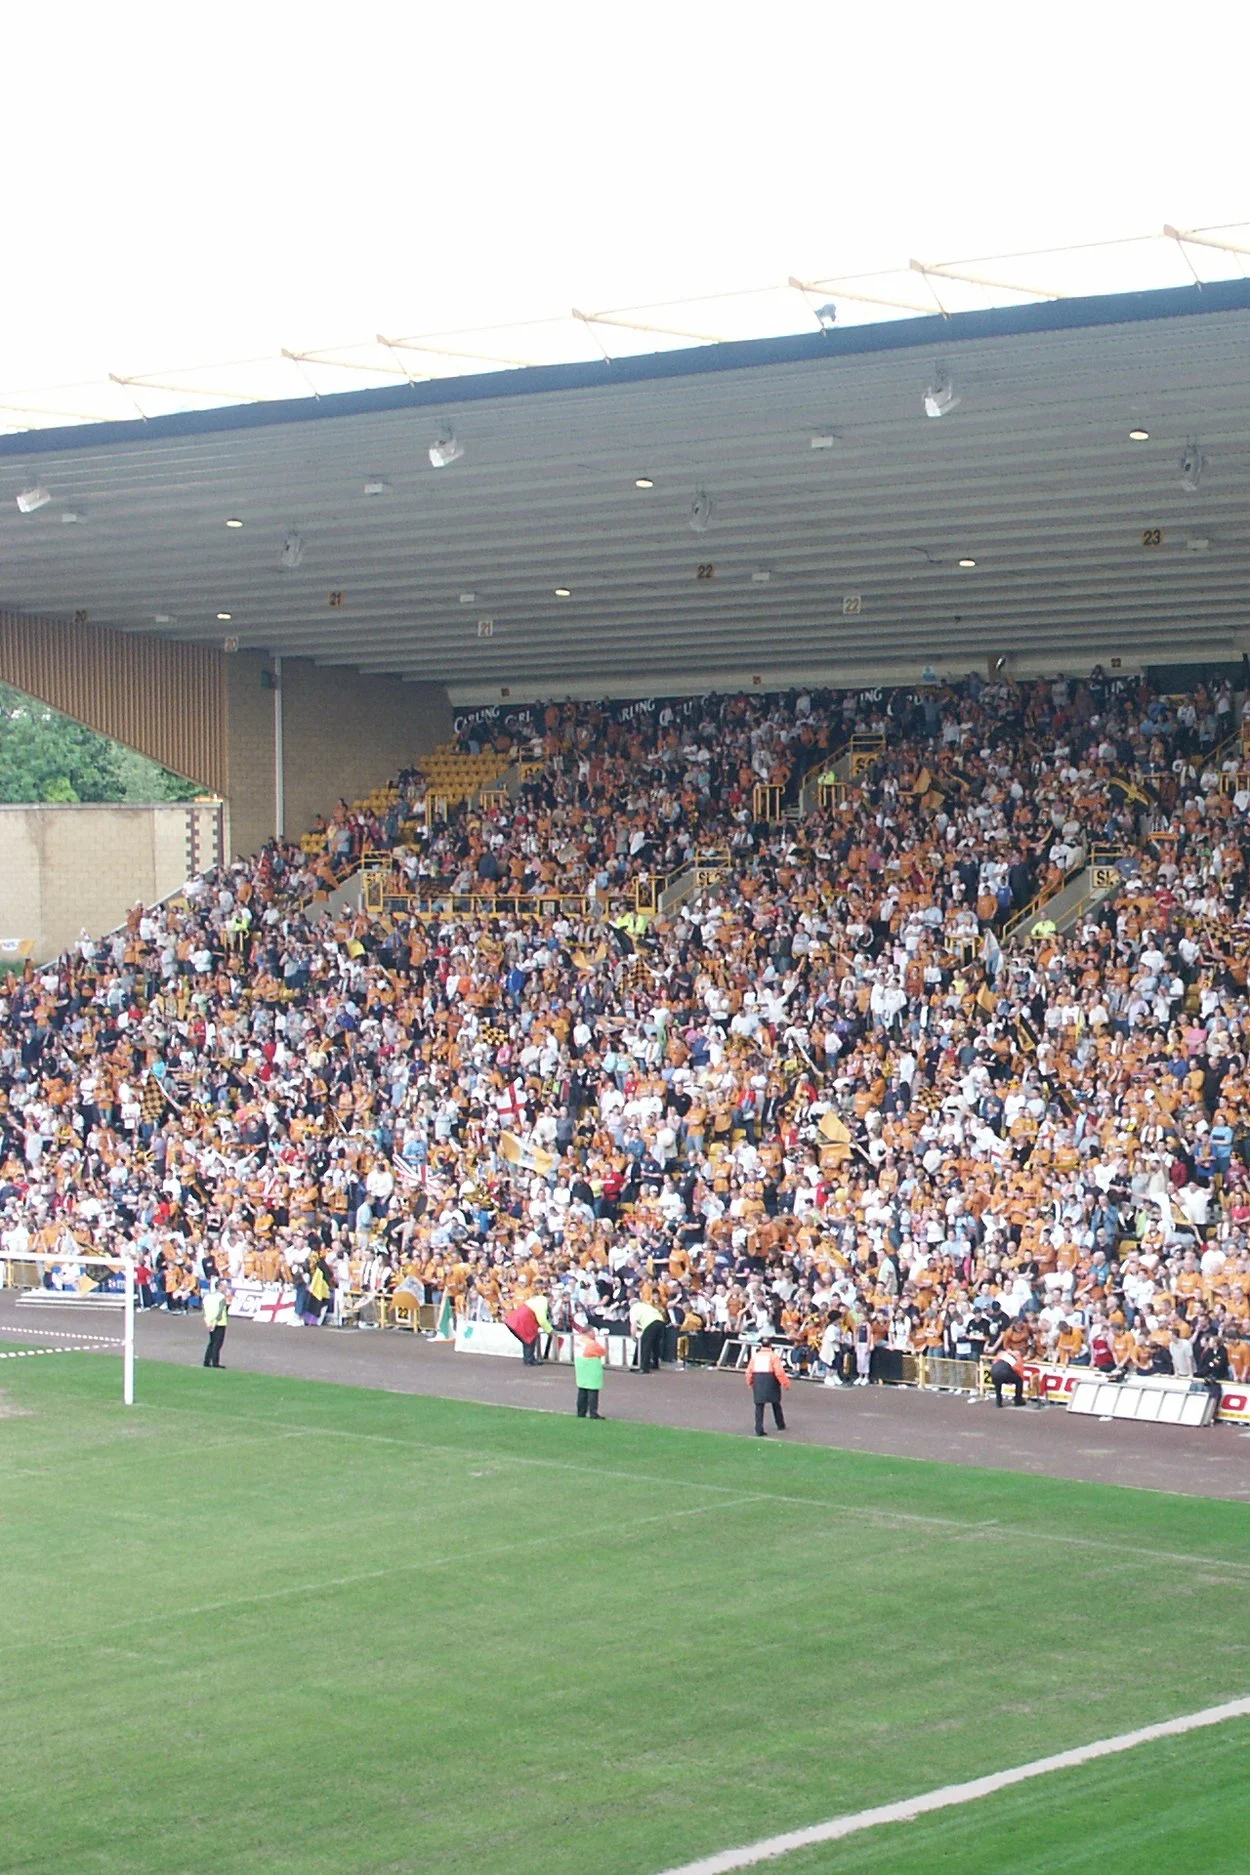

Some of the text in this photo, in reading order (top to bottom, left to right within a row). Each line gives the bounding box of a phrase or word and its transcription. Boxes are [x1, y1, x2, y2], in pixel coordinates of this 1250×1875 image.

[1142, 529, 1161, 546] 23
[697, 564, 713, 579] 22
[844, 597, 860, 612] 22
[396, 1306, 408, 1320] 22
